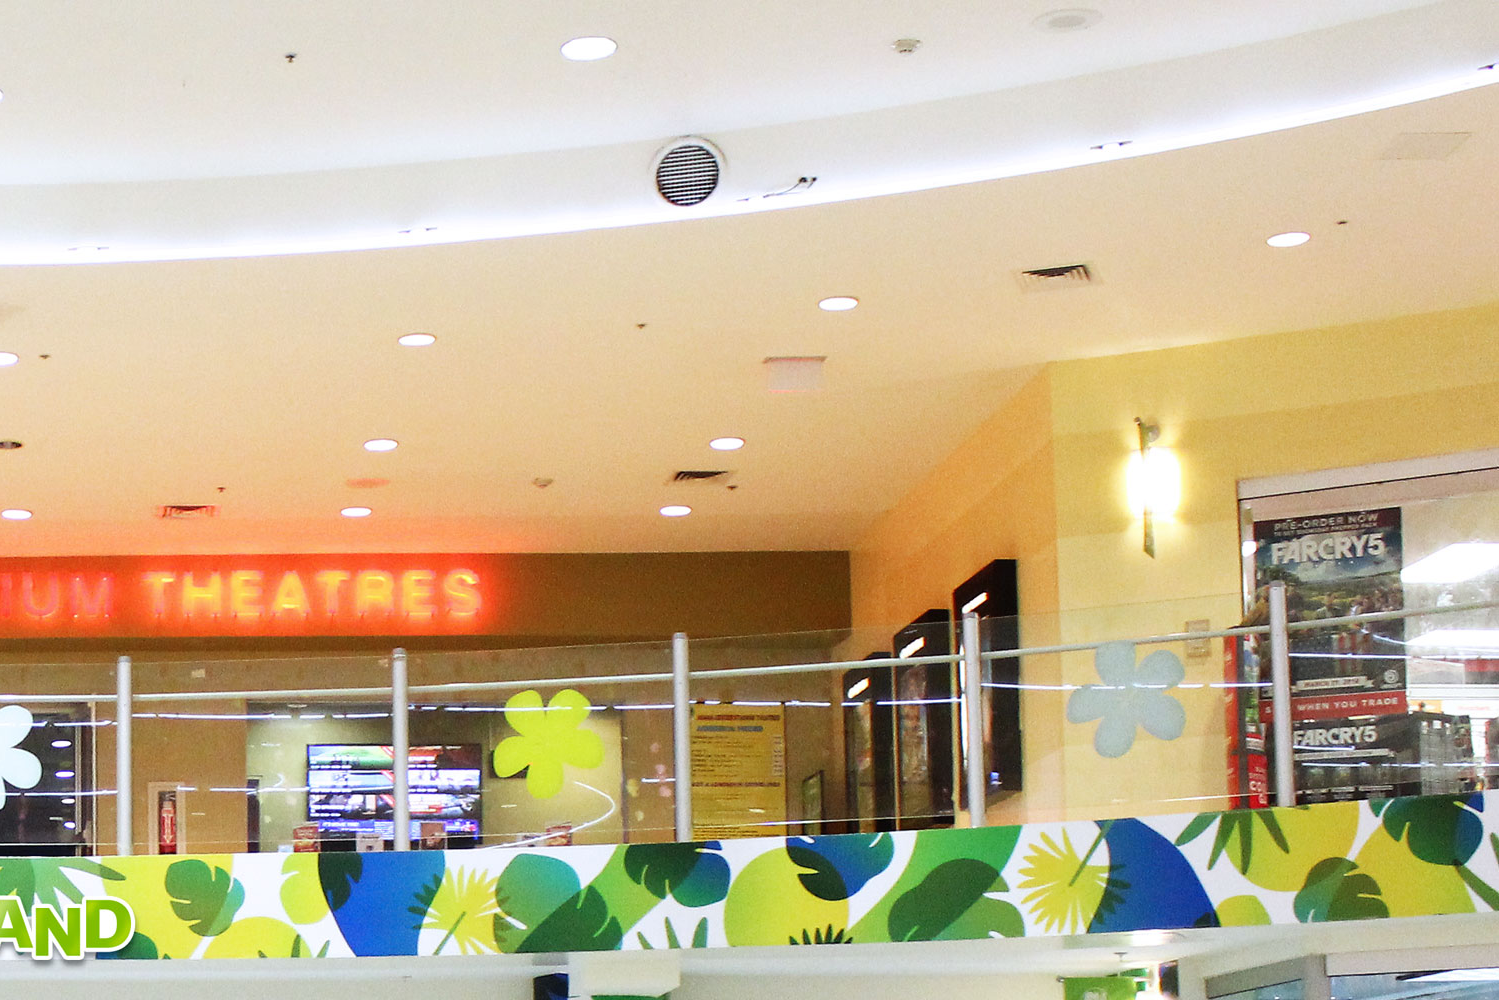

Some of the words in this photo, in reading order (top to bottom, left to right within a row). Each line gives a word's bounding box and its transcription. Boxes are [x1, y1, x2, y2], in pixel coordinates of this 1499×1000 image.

[1274, 518, 1345, 531] PRE-ORDER
[1348, 512, 1379, 524] NOW
[141, 567, 484, 619] THEATRES
[1297, 701, 1330, 711] WHEN
[1333, 700, 1358, 709] YOU
[1361, 697, 1399, 707] TRADE
